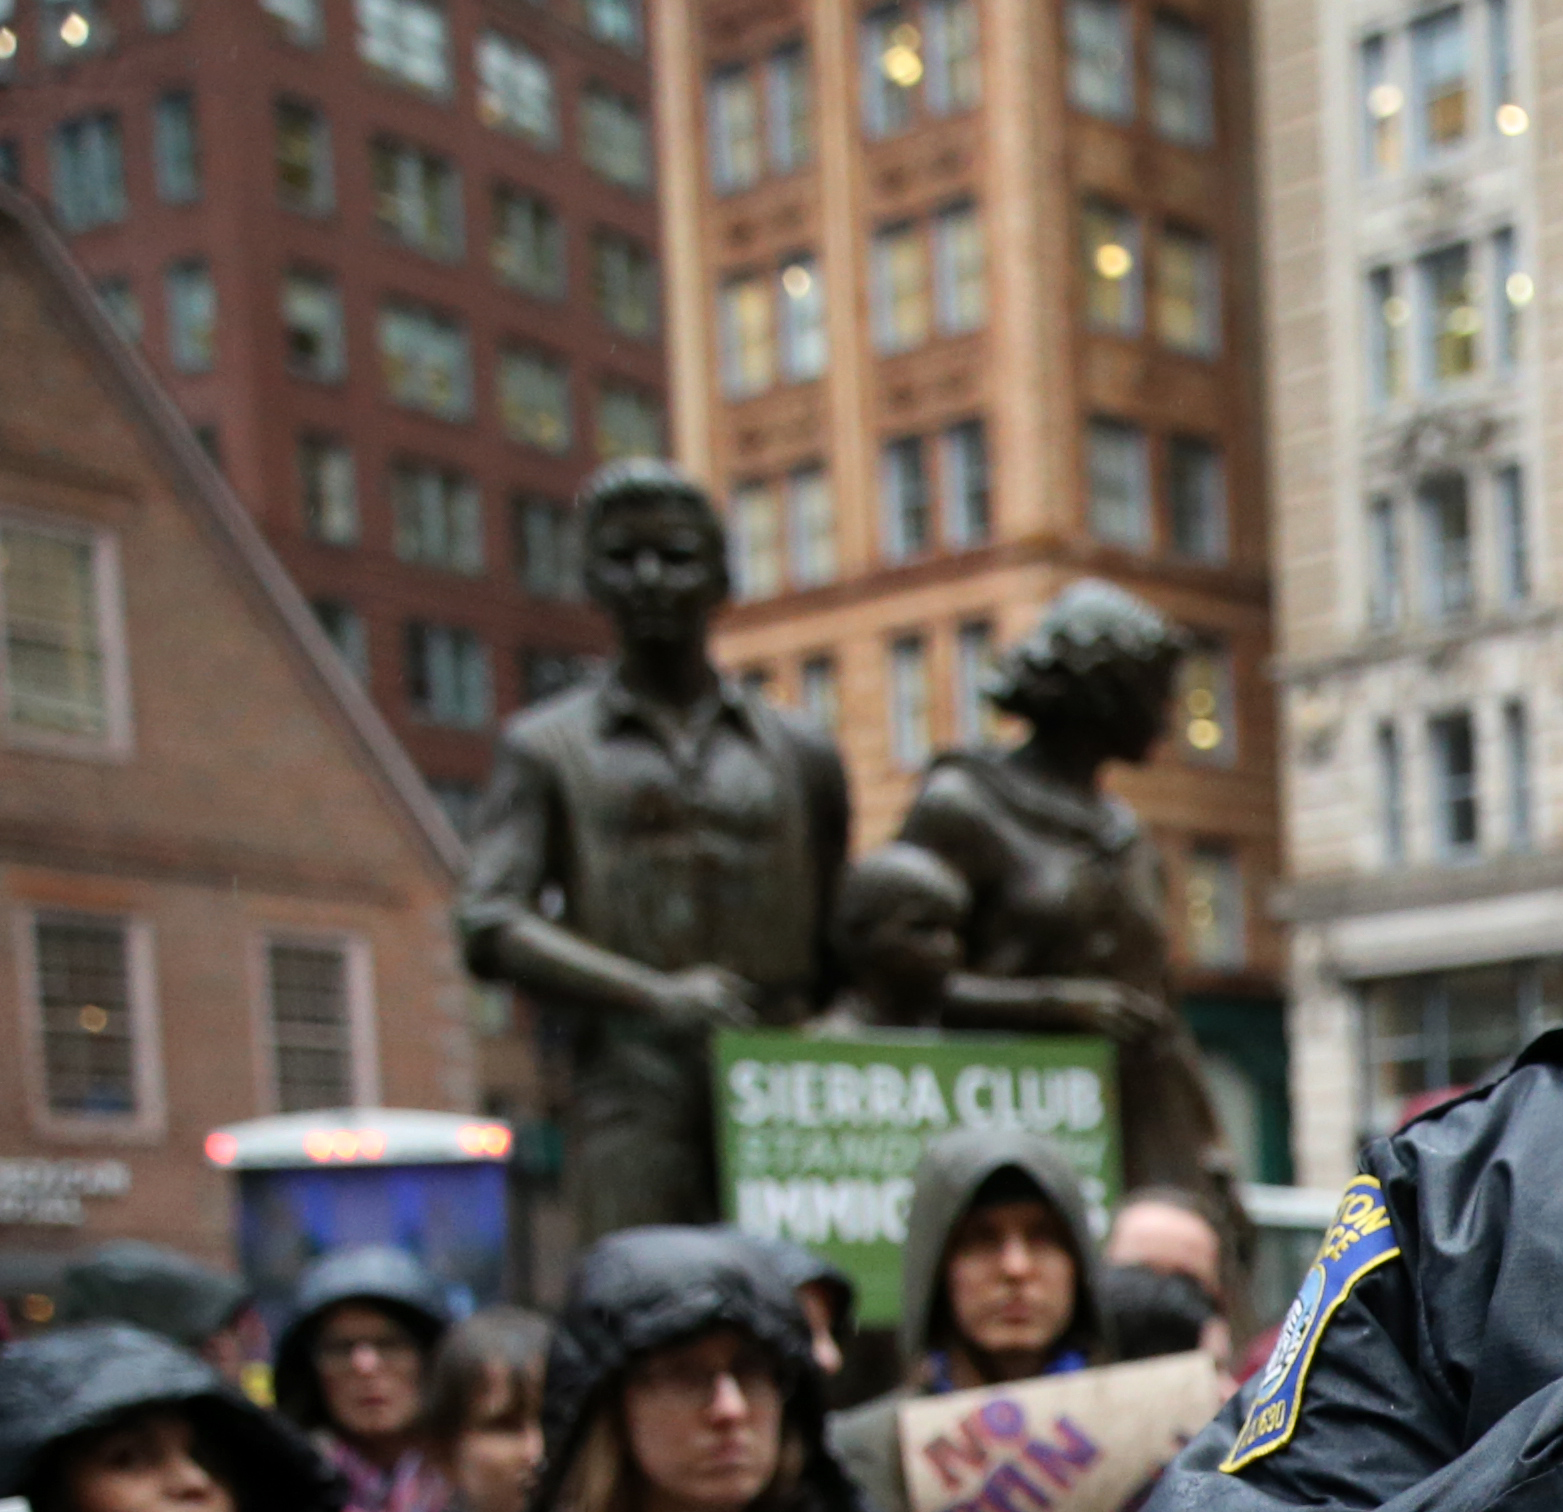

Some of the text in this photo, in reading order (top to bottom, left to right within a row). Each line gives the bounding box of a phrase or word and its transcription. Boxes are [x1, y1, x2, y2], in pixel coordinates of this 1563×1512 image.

[728, 1059, 1104, 1133] SIERRA CLUB
[737, 1131, 922, 1172] STAND
